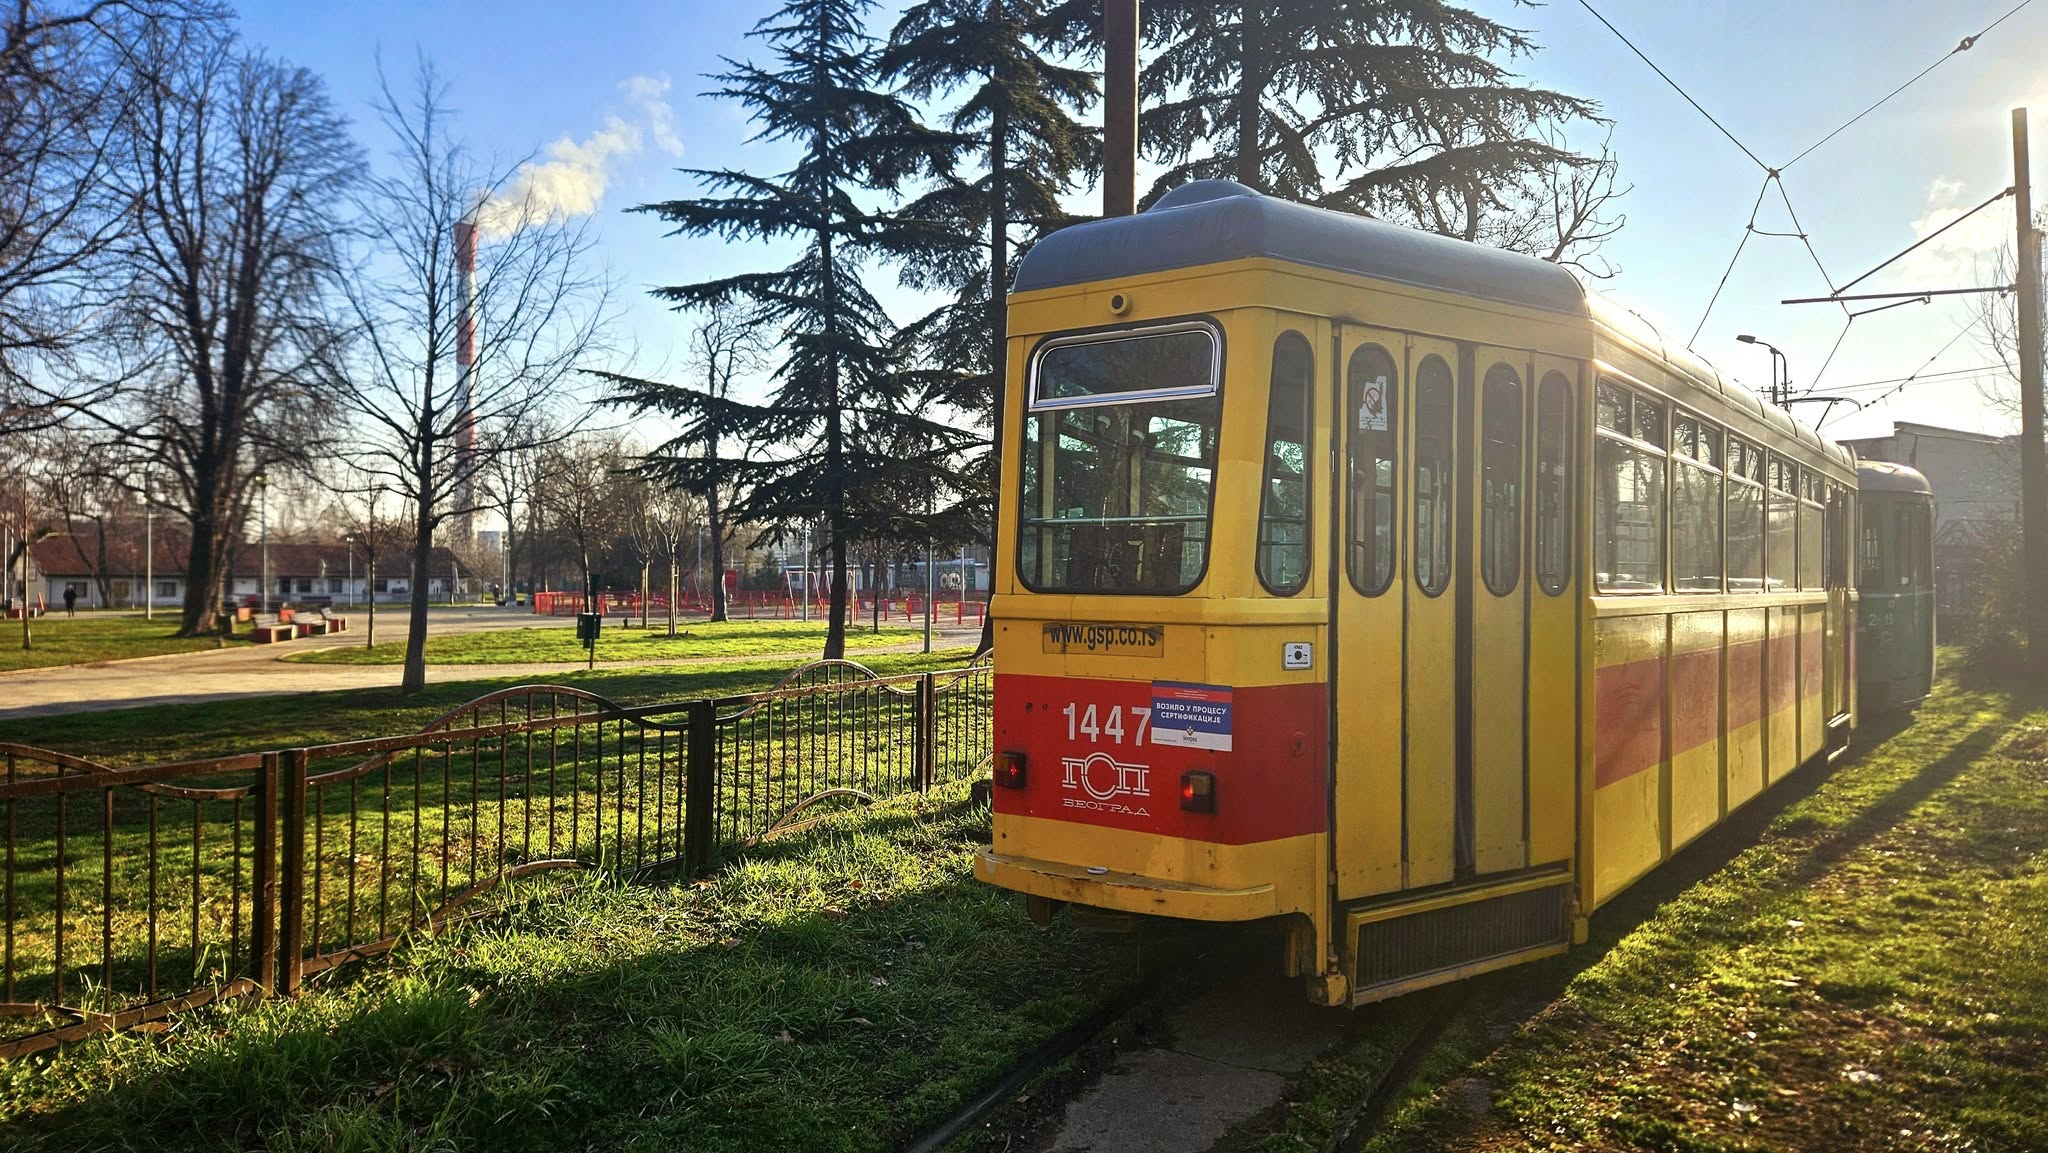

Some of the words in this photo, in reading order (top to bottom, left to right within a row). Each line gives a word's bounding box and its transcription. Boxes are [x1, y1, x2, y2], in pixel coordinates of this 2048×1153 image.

[1050, 626, 1156, 650] www.gsp.co.rs
[1156, 702, 1185, 711] ВОЗИЛО
[1192, 705, 1227, 715] ПРОЦЕСУ
[1160, 711, 1221, 724] СЕРТИФИКАЦИЈЕ
[1063, 703, 1152, 746] 1447
[1062, 752, 1150, 801] ГСП
